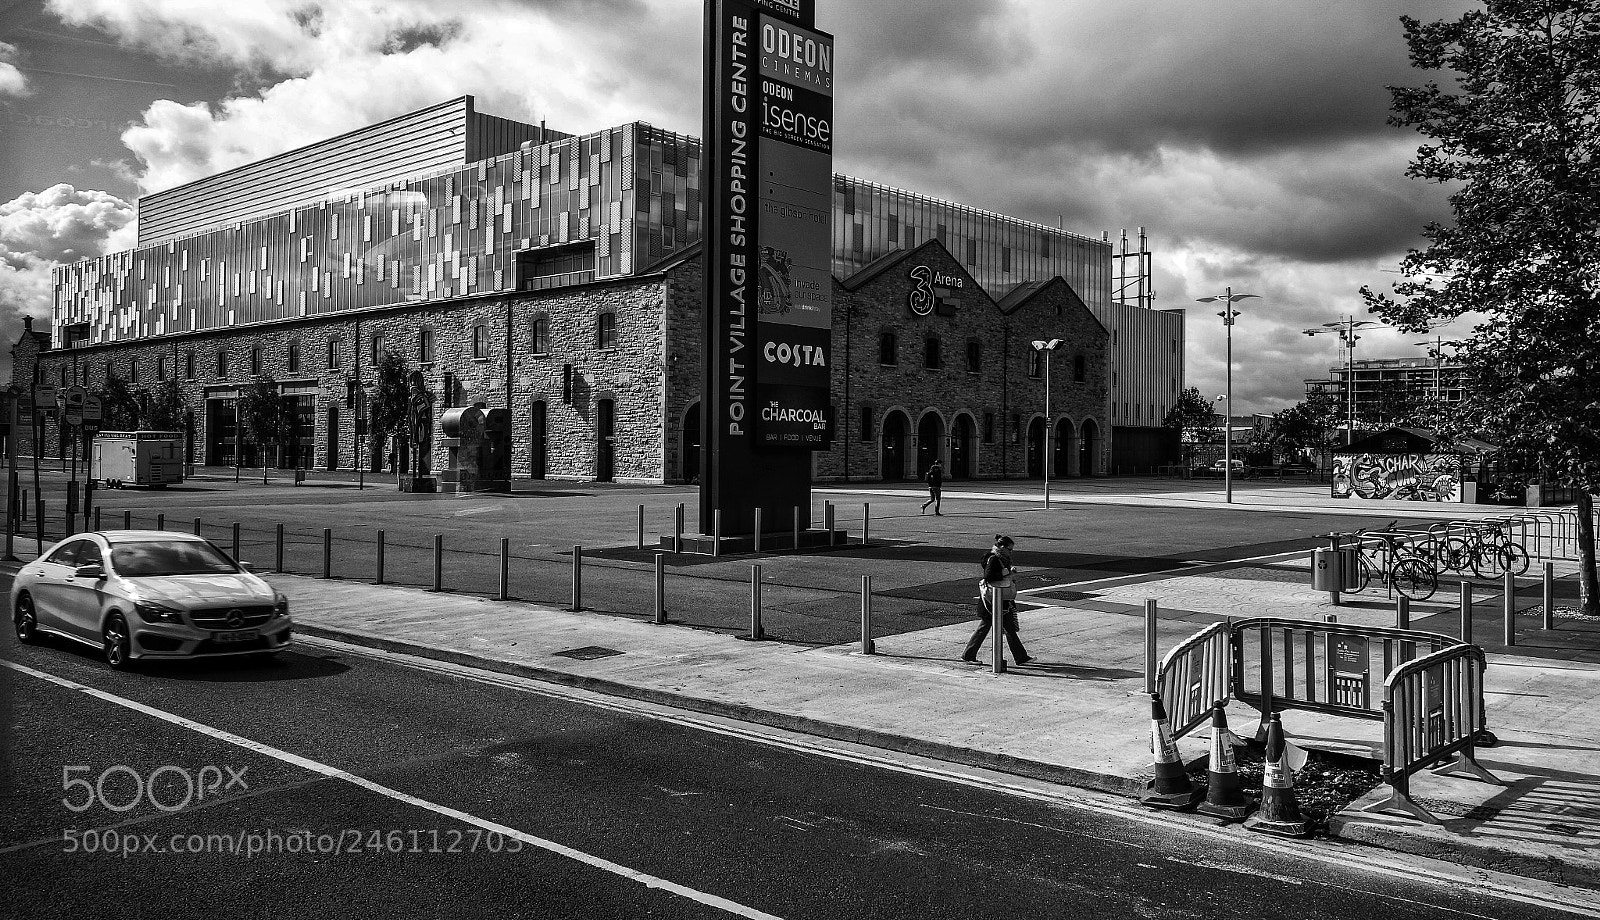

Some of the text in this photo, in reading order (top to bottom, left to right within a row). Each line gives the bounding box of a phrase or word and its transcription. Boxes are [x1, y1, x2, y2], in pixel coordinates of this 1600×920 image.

[775, 4, 800, 19] CENTRE
[763, 23, 830, 74] ODEON
[762, 56, 830, 88] CINEMAS
[762, 80, 793, 102] ODEON
[762, 96, 830, 142] isense
[762, 126, 772, 135] THE
[784, 133, 803, 143] SCREEN
[764, 202, 778, 214] the
[729, 15, 748, 435] POINT VILLAGE SHOPPING CENTRE
[794, 278, 820, 290] invade
[934, 271, 963, 289] Arena
[763, 341, 826, 368] COSTA
[762, 407, 827, 423] CHARCOAL
[766, 433, 777, 441] BAR
[805, 434, 822, 442] VENUE
[1386, 453, 1423, 474] CHAR
